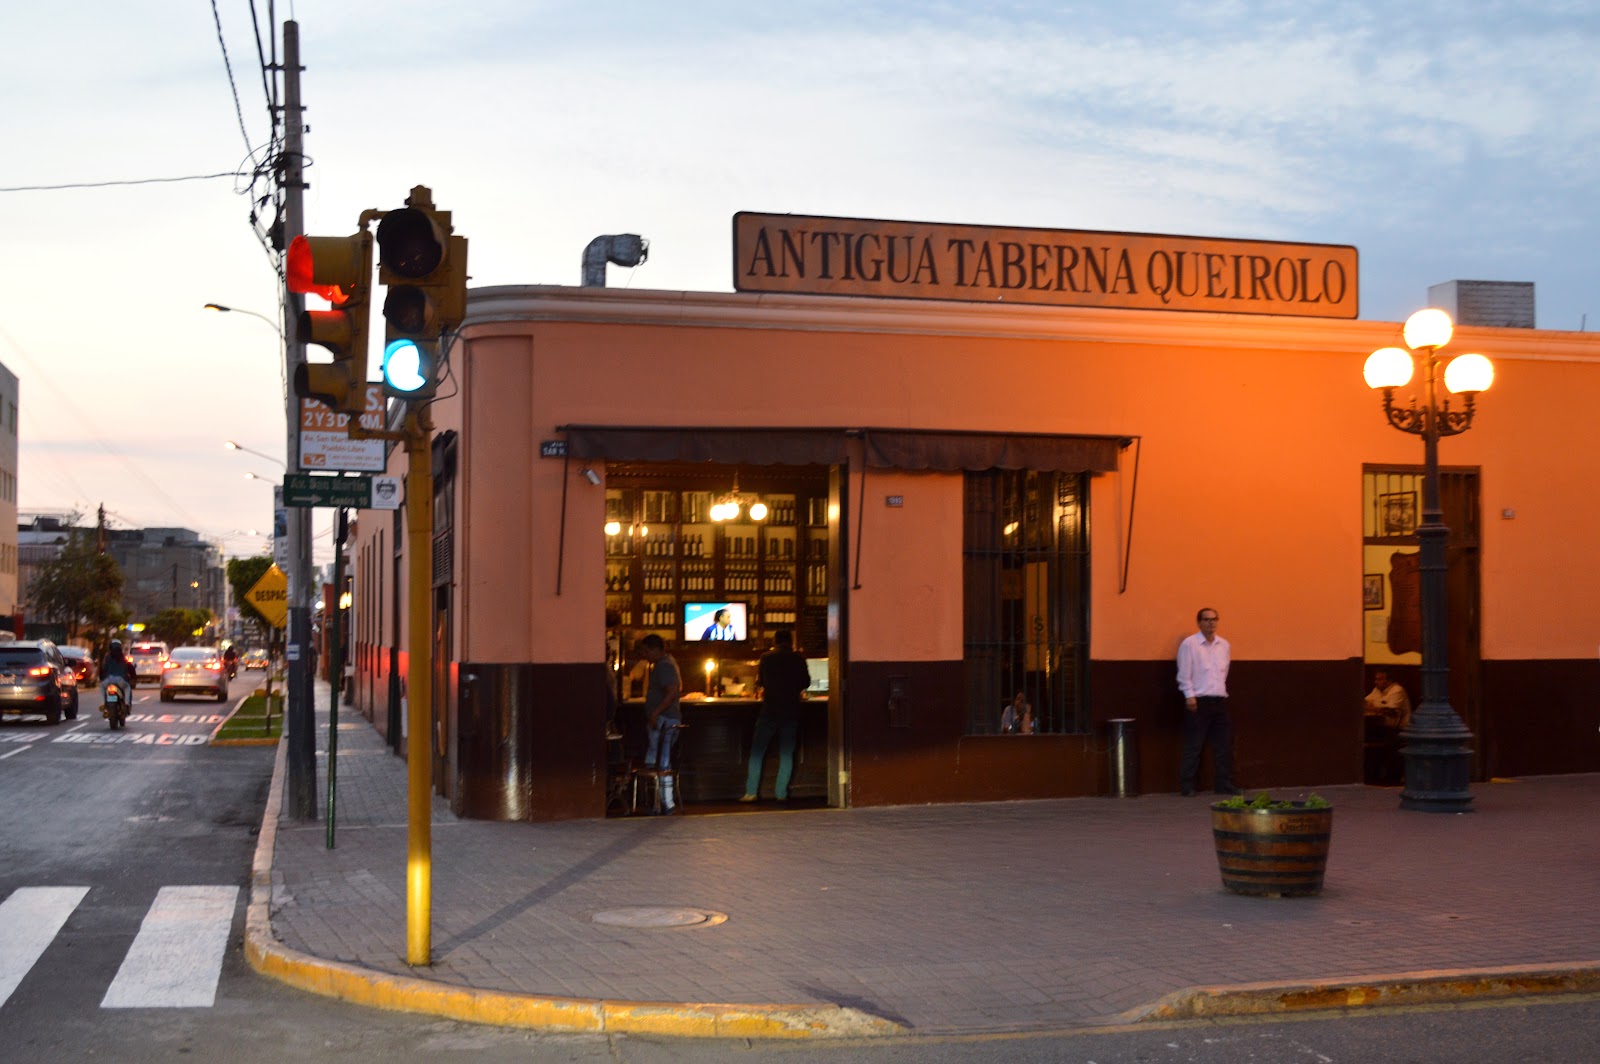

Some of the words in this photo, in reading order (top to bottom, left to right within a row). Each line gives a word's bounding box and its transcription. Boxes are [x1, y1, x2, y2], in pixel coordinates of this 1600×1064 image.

[746, 226, 940, 286] ANTIGUA
[947, 238, 1138, 295] TABERNA
[1146, 249, 1347, 305] QUEIROLO
[255, 589, 287, 601] DESPAC
[106, 713, 225, 723] OLEGIO
[51, 732, 209, 745] DESPACIO
